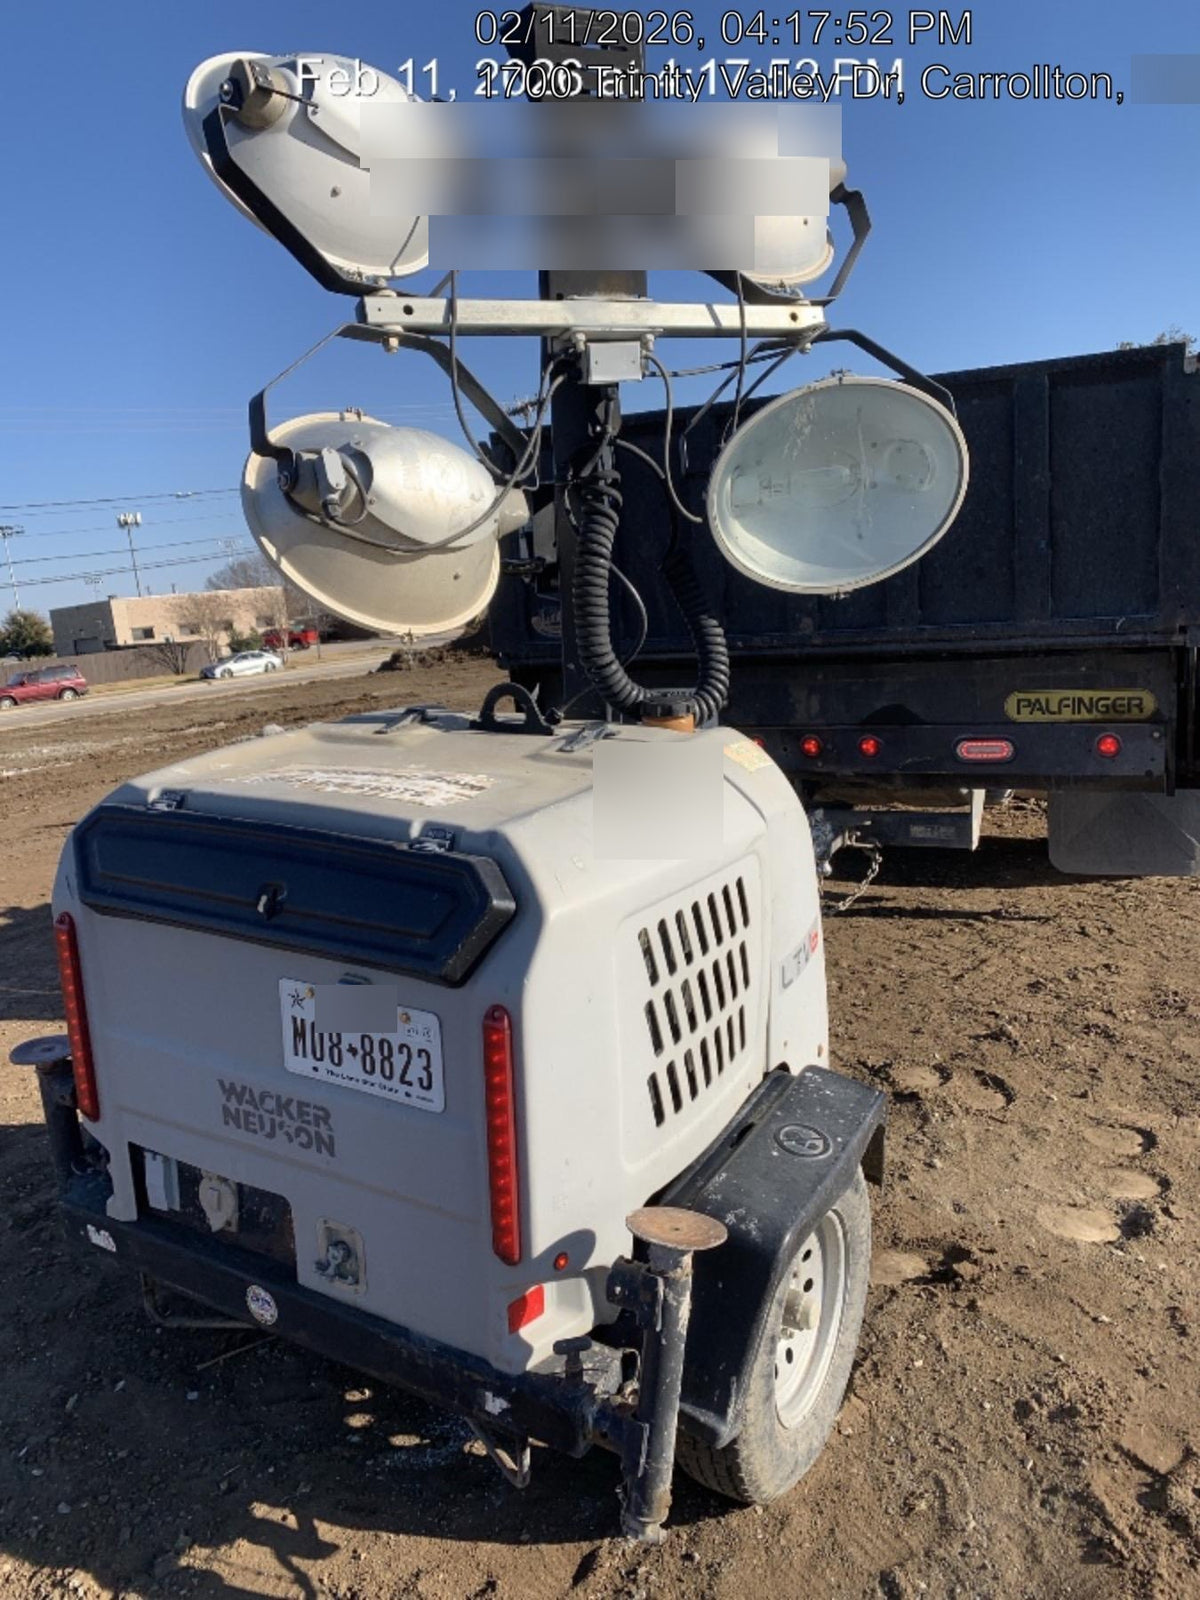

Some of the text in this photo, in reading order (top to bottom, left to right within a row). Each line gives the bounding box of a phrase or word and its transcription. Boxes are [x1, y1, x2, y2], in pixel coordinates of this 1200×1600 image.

[1016, 697, 1144, 715] PALFINGER
[360, 1033, 433, 1091] 8823
[217, 1078, 334, 1132] WACKER
